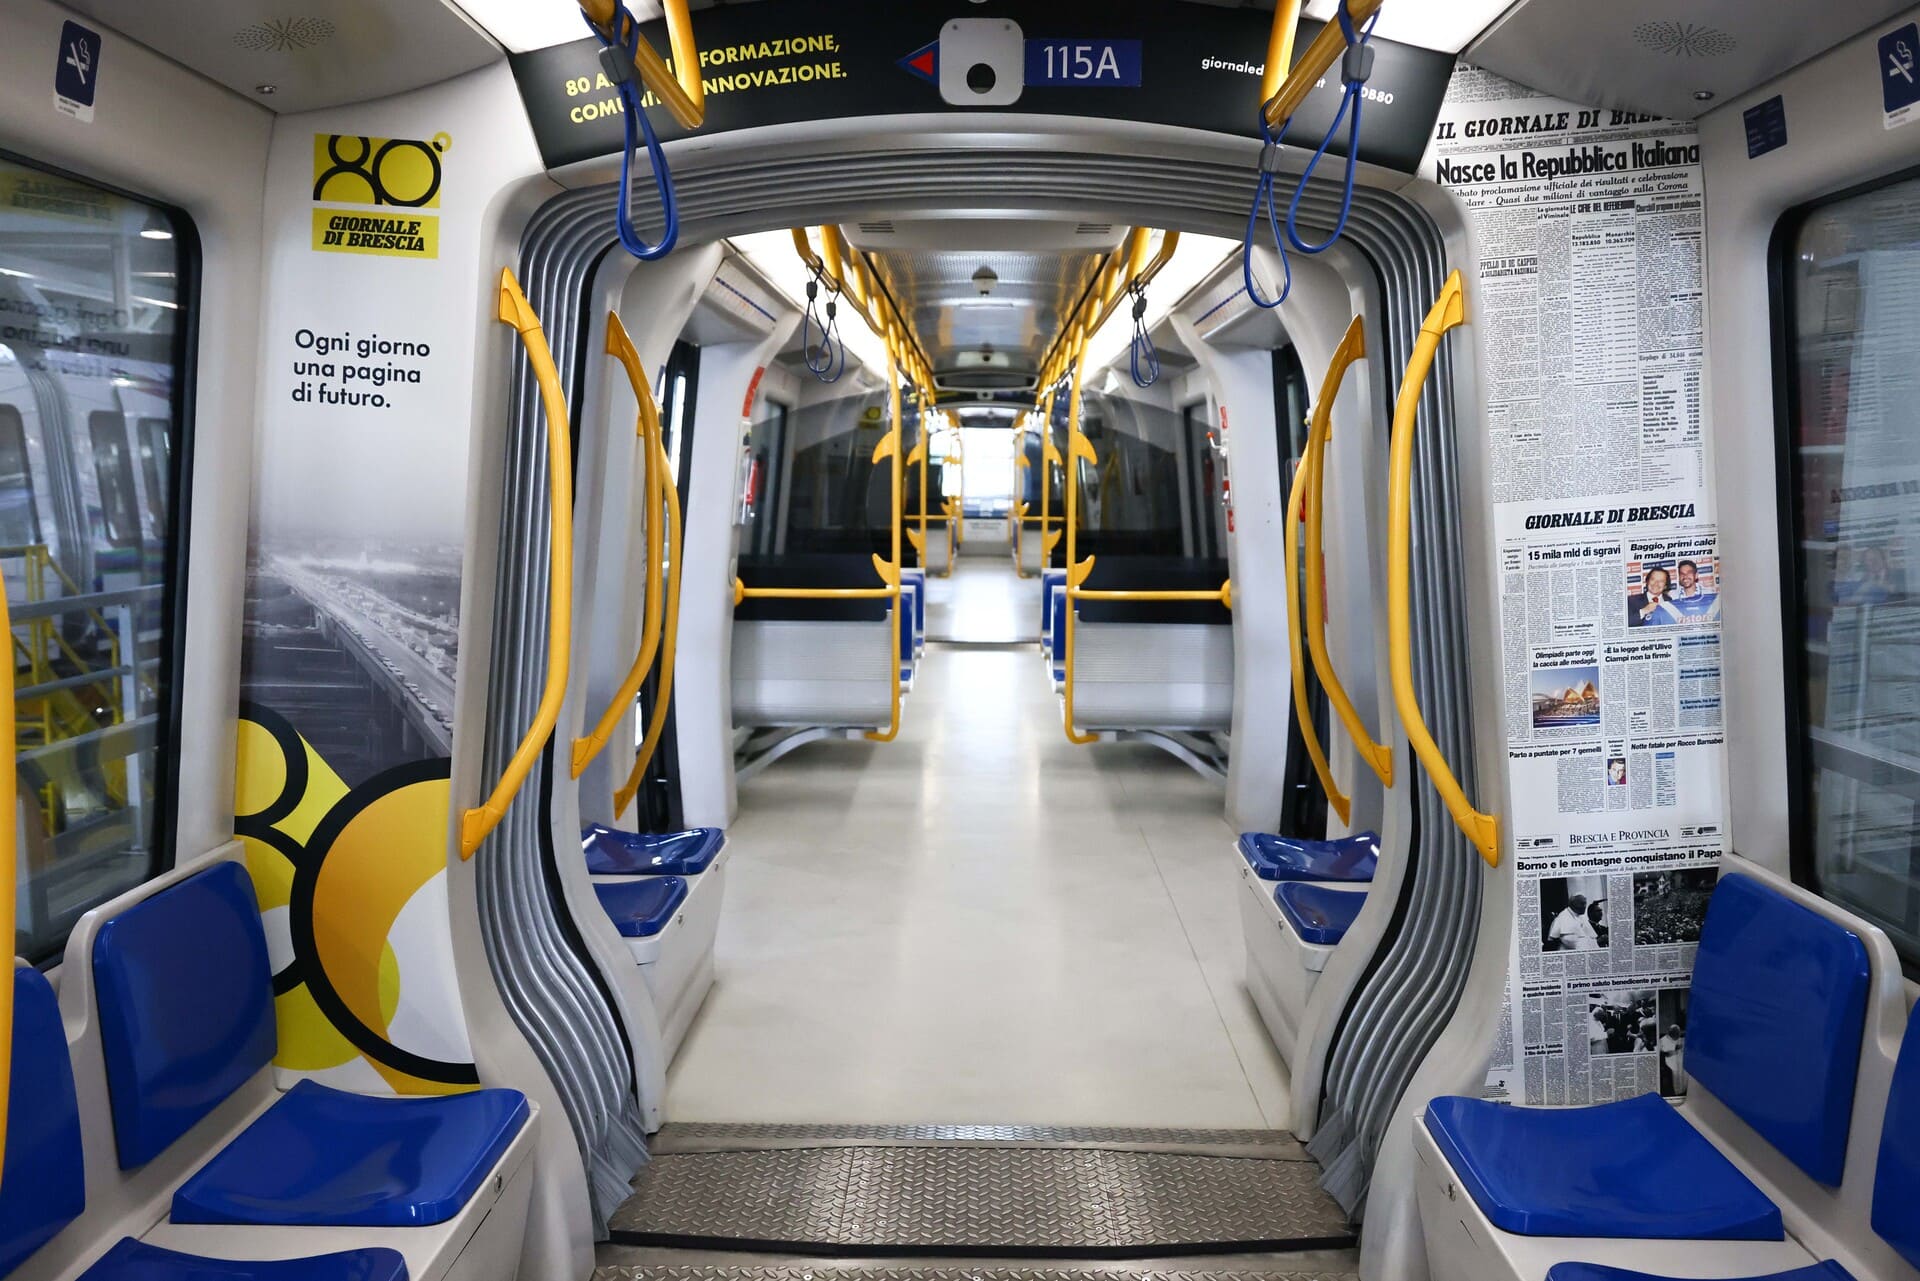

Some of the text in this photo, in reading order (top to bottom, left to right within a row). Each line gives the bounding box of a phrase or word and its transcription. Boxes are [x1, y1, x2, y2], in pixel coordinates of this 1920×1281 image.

[565, 76, 591, 97] 80
[699, 34, 840, 68] FORMAZIONE,
[1043, 45, 1121, 79] 115A
[702, 62, 847, 96] NNOVAZIONE.
[1436, 122, 1457, 140] IL
[1464, 112, 1570, 138] GIORNALE
[1576, 109, 1601, 129] DI
[1436, 158, 1496, 185] Nasce
[1500, 154, 1518, 180] la
[1522, 145, 1628, 181] Repubblica
[1631, 140, 1701, 170] Italiana
[1481, 183, 1541, 198] proclamazione
[1543, 180, 1579, 192] ufficiale
[1580, 177, 1593, 188] dei
[1595, 175, 1629, 186] risultati
[1638, 171, 1689, 183] celebrazione
[1496, 194, 1522, 206] Quasi
[1524, 193, 1540, 204] due
[1543, 190, 1574, 201] milioni
[1576, 189, 1586, 199] di
[1588, 186, 1630, 198] vantaggio
[1633, 184, 1655, 194] sulla
[1657, 181, 1689, 192] Corona
[329, 215, 421, 236] GIORNALE
[322, 230, 425, 252] DI BRESCIA
[295, 328, 431, 359] Ogni giorno
[293, 361, 421, 387] una pagina
[291, 381, 391, 408] di futuro.
[1525, 503, 1696, 530] GIORNALE DI BRESCIA
[1527, 550, 1541, 561] 15
[1542, 548, 1561, 560] mila
[1563, 547, 1581, 558] mld
[1582, 546, 1592, 556] di
[1593, 544, 1621, 558] sgravi
[1630, 541, 1666, 552] Baggio,
[1667, 537, 1693, 550] primi
[1693, 537, 1717, 547] calci
[1633, 548, 1713, 560] in maglia azzurra
[1565, 649, 1581, 659] parte
[1582, 647, 1595, 657] oggi
[1605, 654, 1630, 663] Ciampi
[1630, 654, 1644, 662] non
[1620, 645, 1640, 654] legge
[1539, 660, 1559, 668] caccia
[1570, 656, 1598, 667] medaglie
[1509, 751, 1528, 759] Parto
[1533, 749, 1559, 759] puntate
[1559, 748, 1571, 757] per
[1572, 747, 1577, 755] 7
[1630, 742, 1648, 751] Notte
[1648, 741, 1665, 750] fatale
[1666, 741, 1677, 749] per
[1677, 738, 1696, 747] Rocco
[1569, 832, 1609, 845] BRESCIA
[1611, 831, 1617, 842] E
[1618, 828, 1670, 841] PROVINCIA
[1516, 861, 1548, 871] Borno
[1550, 860, 1557, 869] e
[1559, 859, 1569, 868] le
[1571, 856, 1622, 868] montagne
[1624, 852, 1686, 865] conquistano
[1688, 849, 1695, 859] il
[1697, 848, 1722, 860] Papa
[1572, 981, 1591, 989] primo
